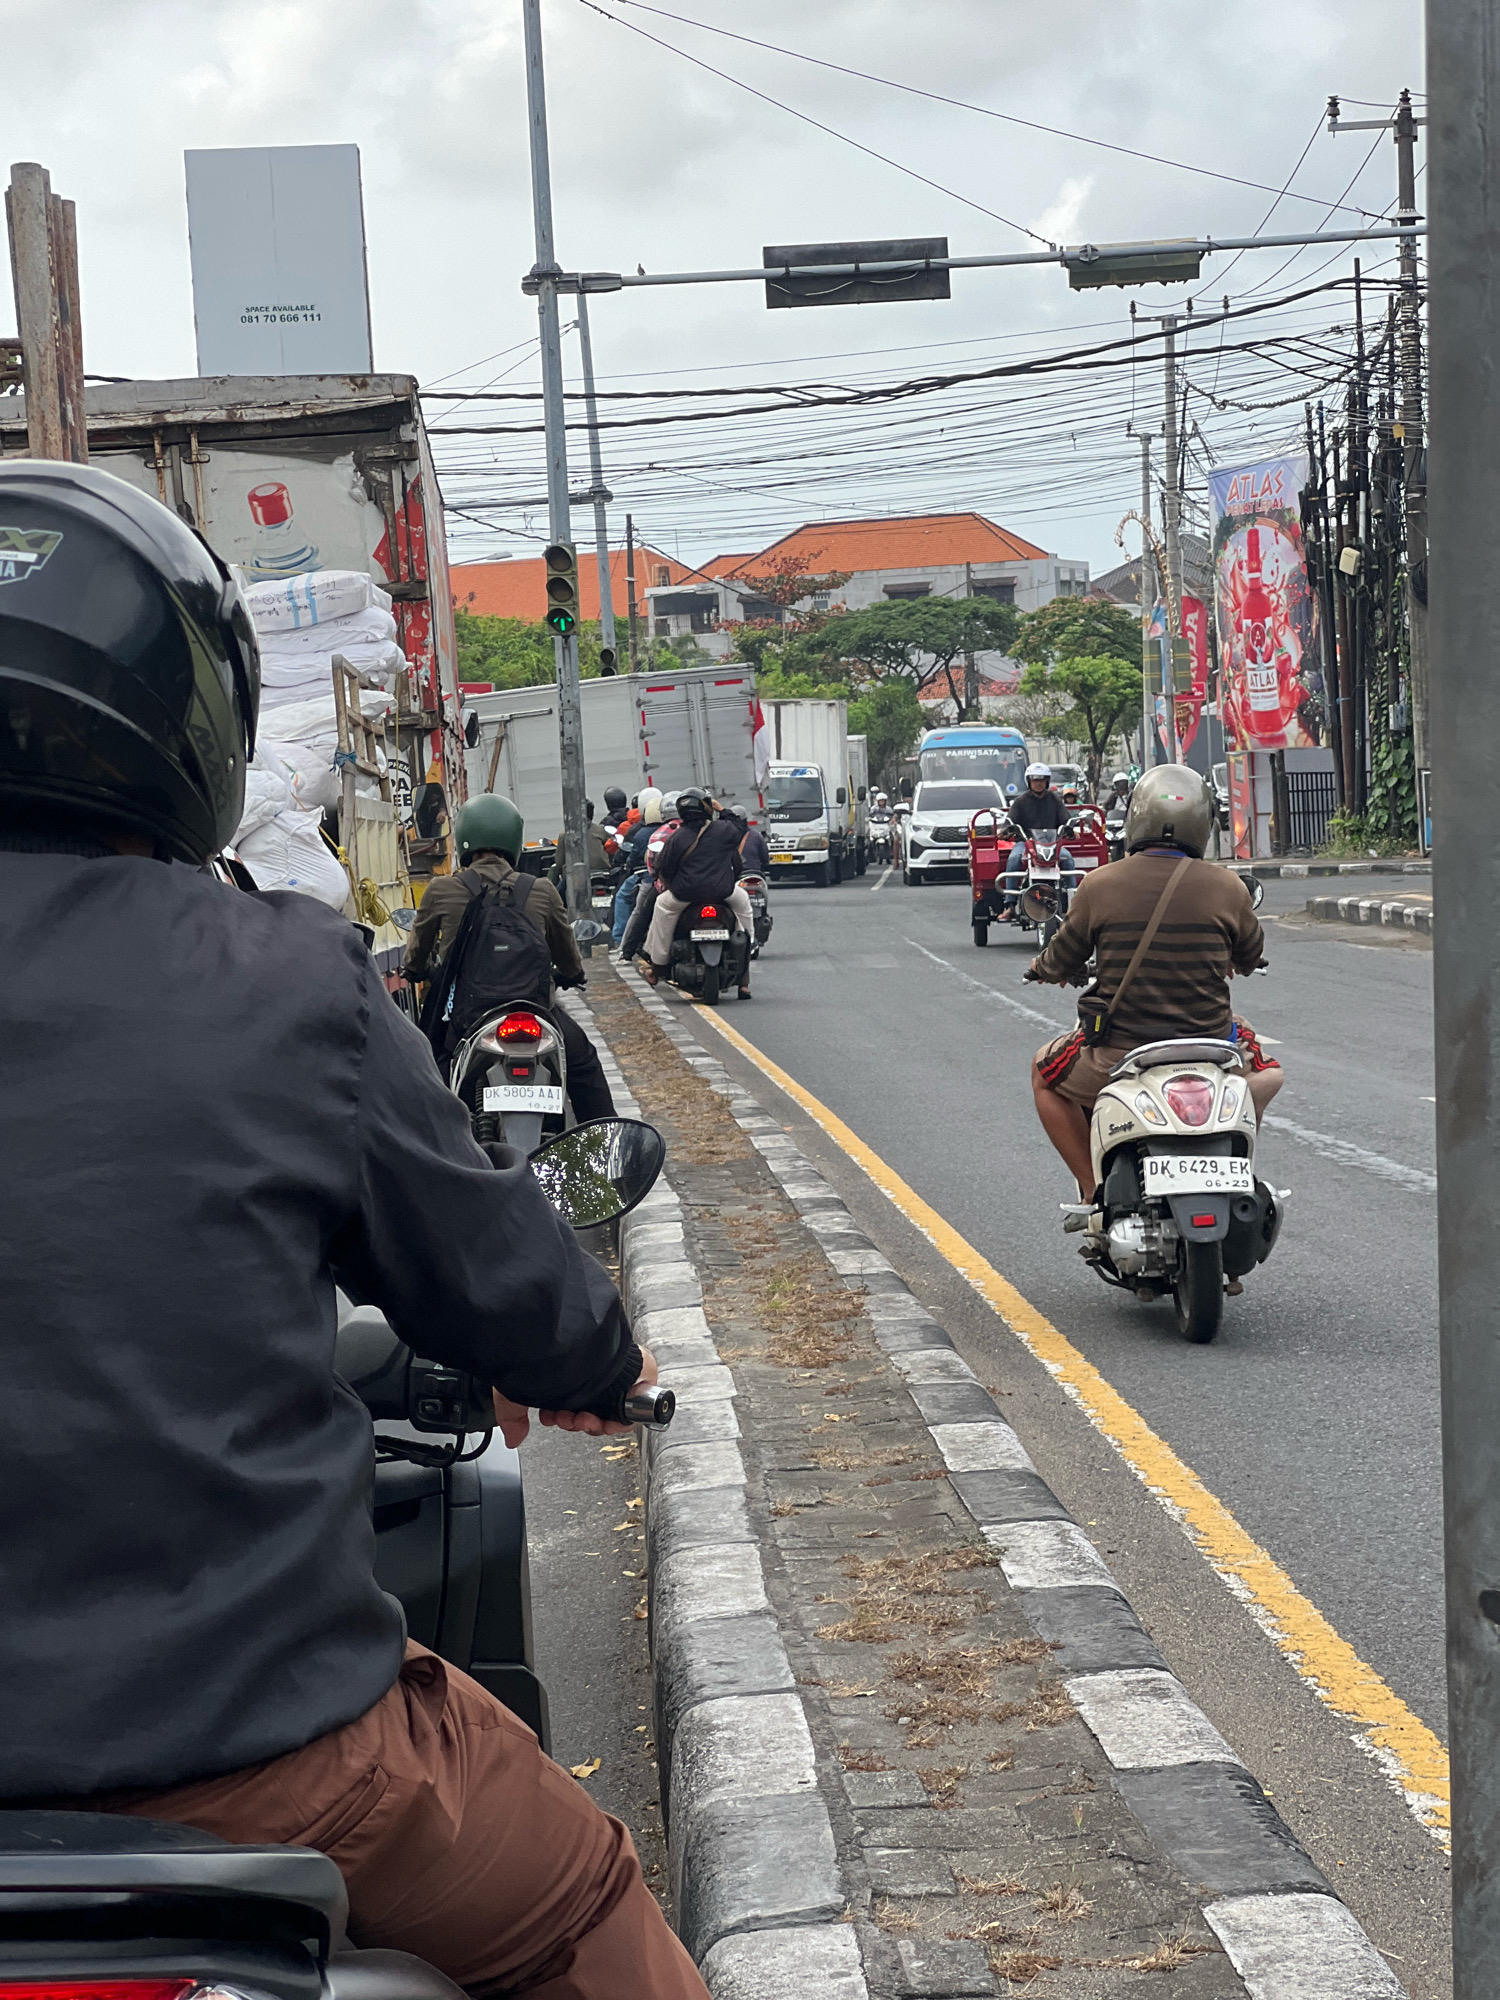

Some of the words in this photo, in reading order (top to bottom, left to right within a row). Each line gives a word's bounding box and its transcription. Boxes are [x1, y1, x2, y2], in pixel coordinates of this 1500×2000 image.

[272, 304, 316, 312] AVAILABLE
[240, 315, 259, 323] 081
[263, 314, 277, 323] 70
[279, 313, 299, 322] 666
[302, 313, 321, 322] 111
[1227, 468, 1284, 502] ATLAS
[1250, 671, 1275, 688] ATLAS
[946, 749, 1000, 757] PARIWISATA
[485, 1088, 500, 1099] DK
[503, 1086, 534, 1098] 5805
[1150, 1160, 1172, 1175] DK
[1179, 1160, 1219, 1174] 6429
[1230, 1160, 1250, 1175] EK
